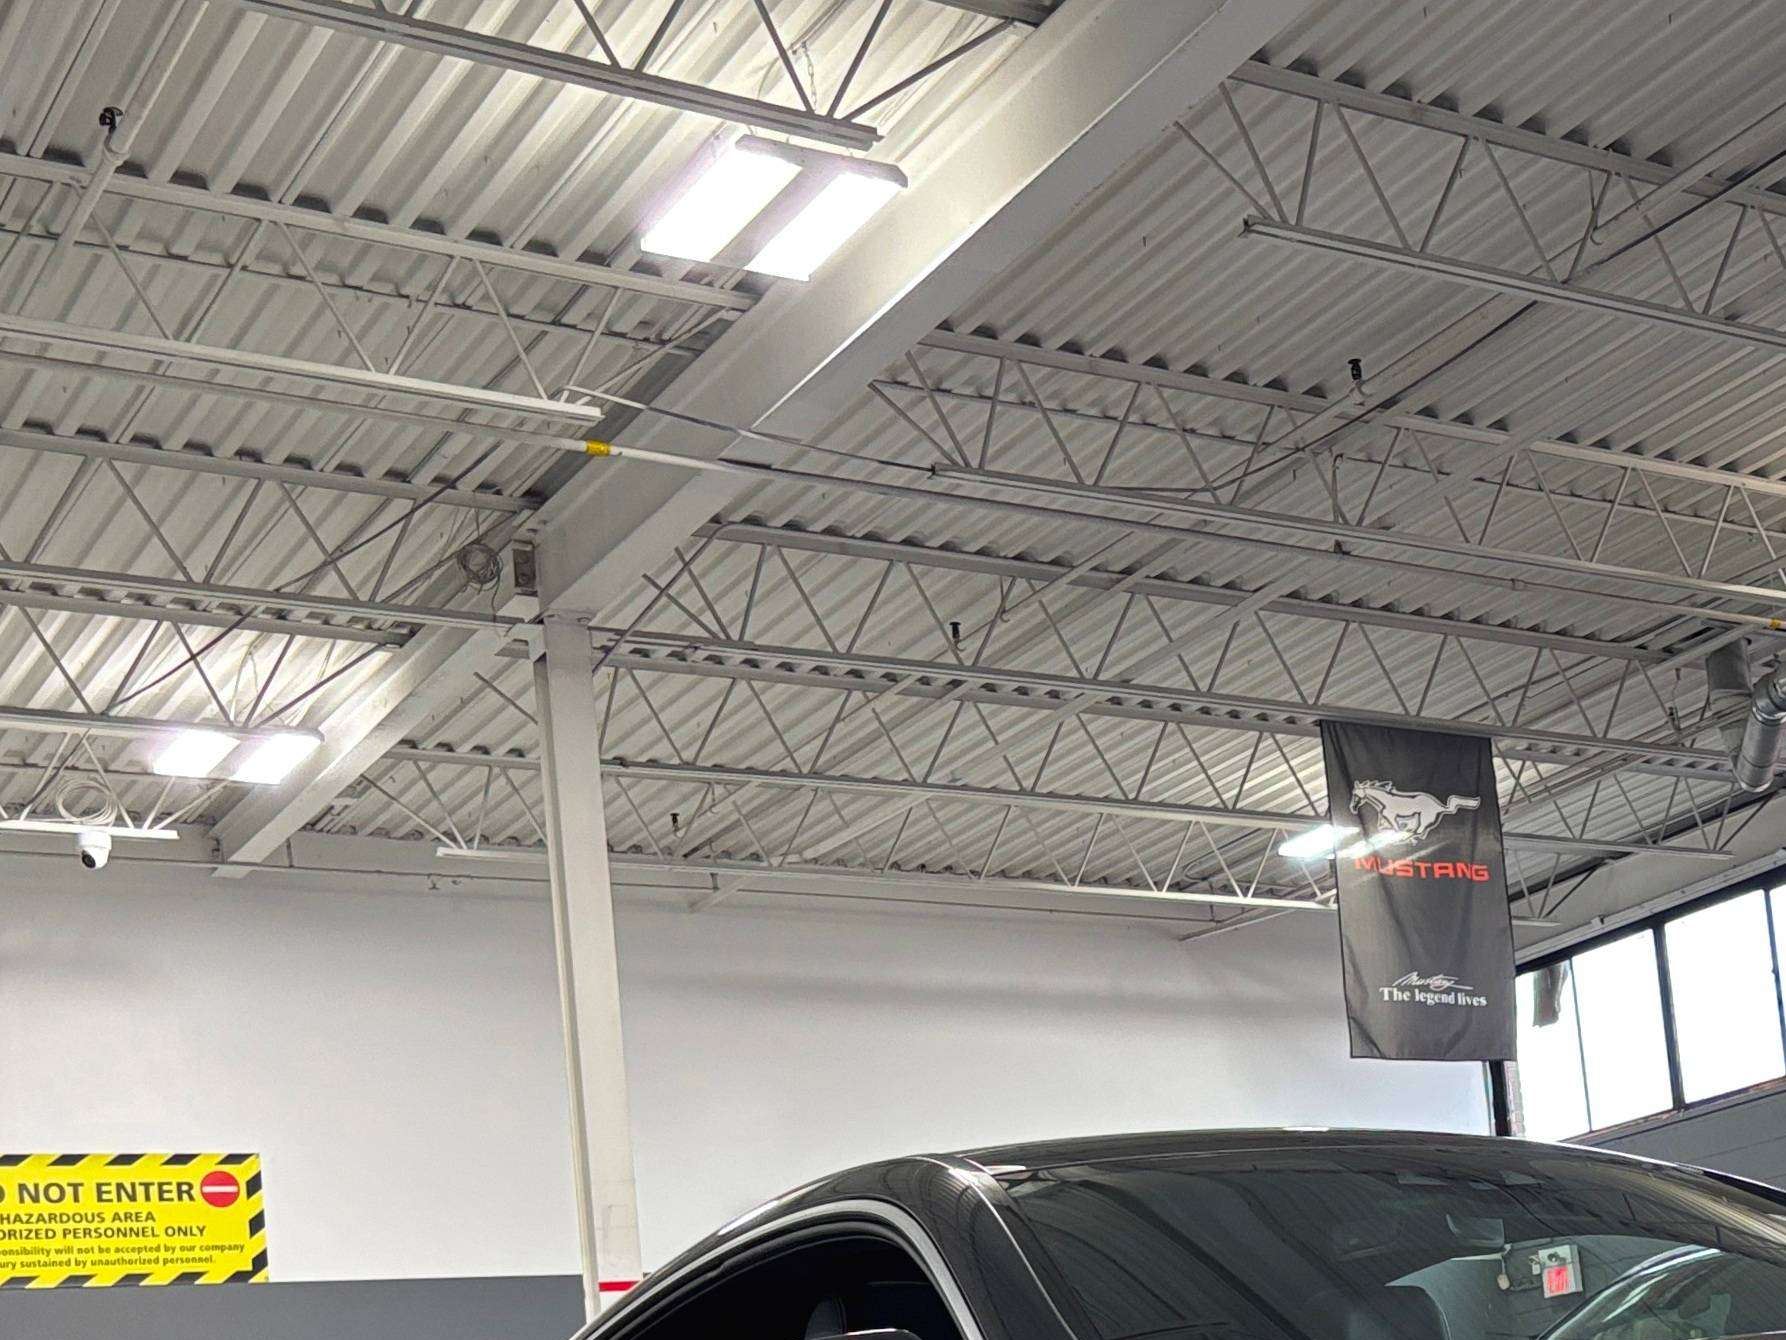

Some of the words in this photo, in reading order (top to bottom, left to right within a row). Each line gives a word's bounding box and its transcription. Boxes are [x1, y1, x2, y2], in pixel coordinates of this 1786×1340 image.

[1354, 855, 1490, 882] MUSTANG
[1379, 986, 1412, 1002] The
[1414, 988, 1456, 1006] legend
[1457, 992, 1488, 1007] lives
[18, 1182, 84, 1204] NOT
[96, 1181, 196, 1203] ENTER
[0, 1212, 106, 1225] HAZARDOUS
[111, 1211, 156, 1223] AREA
[62, 1226, 160, 1239] PERSONNEL
[164, 1225, 206, 1237] ONLY
[54, 1245, 74, 1255] will
[77, 1245, 95, 1255] not
[98, 1245, 112, 1255] be
[113, 1244, 160, 1255] accepted
[163, 1243, 177, 1254] by
[180, 1244, 196, 1253] our
[199, 1243, 245, 1254] company
[20, 1257, 72, 1268] sustained
[75, 1257, 88, 1269] by
[90, 1256, 159, 1267] unauthorized
